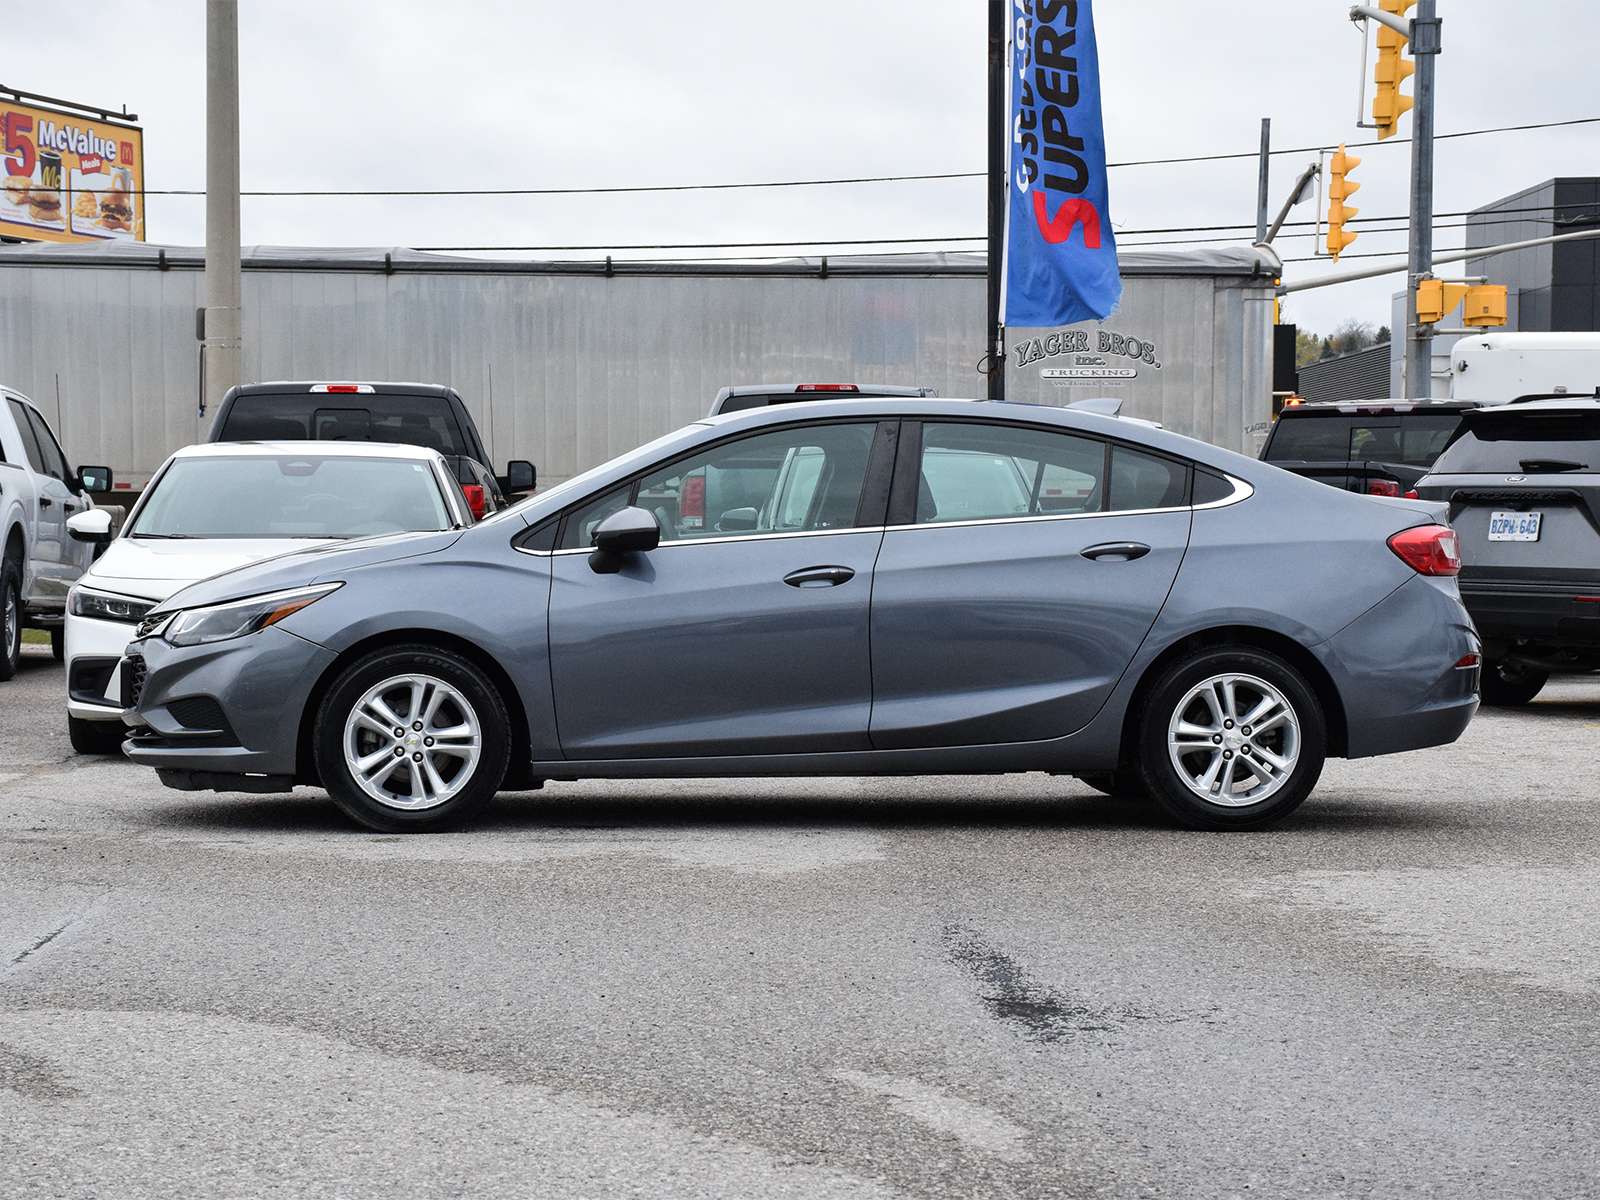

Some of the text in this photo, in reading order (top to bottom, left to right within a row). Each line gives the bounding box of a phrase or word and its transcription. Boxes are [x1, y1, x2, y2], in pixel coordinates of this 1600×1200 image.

[38, 120, 116, 160] McValue
[1014, 330, 1161, 368] YAGER BROS.
